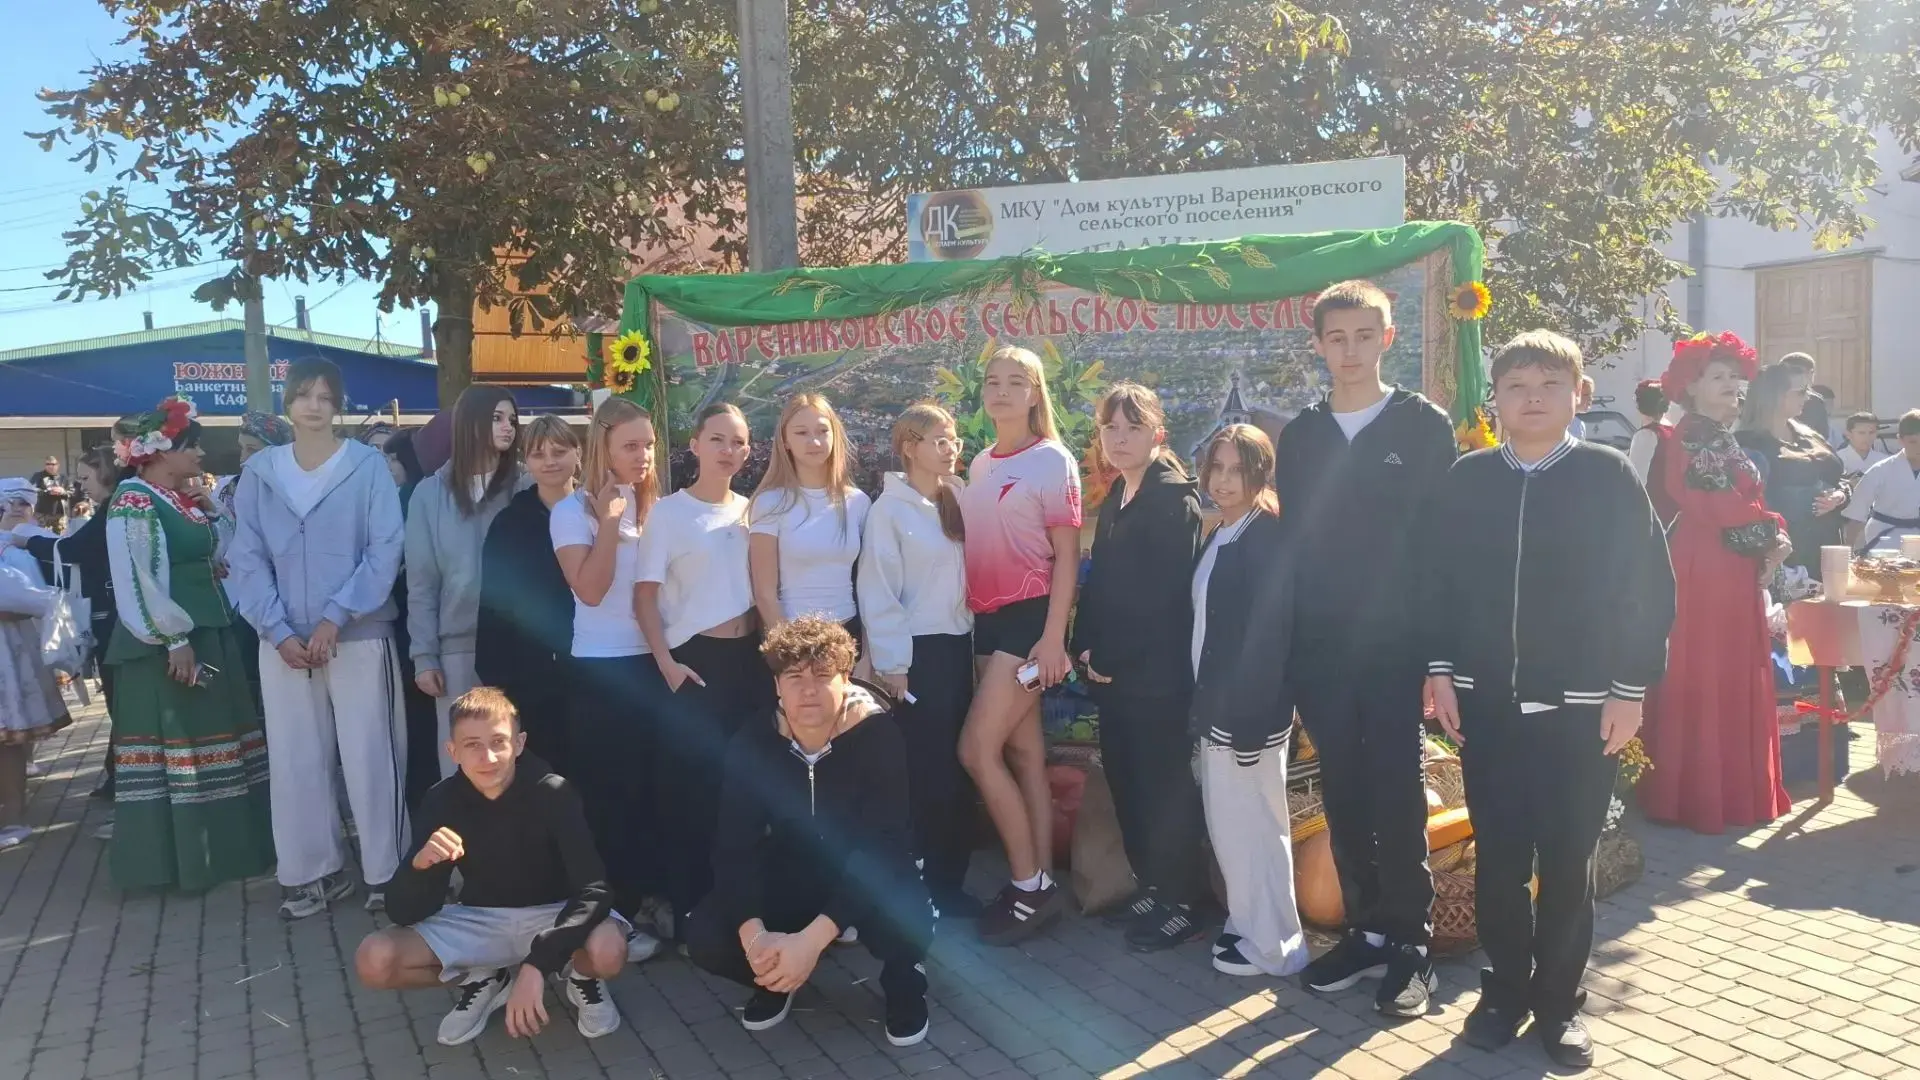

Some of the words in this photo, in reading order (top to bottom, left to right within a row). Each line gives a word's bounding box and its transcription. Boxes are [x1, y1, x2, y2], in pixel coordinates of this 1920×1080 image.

[1000, 199, 1046, 220] МКУ
[1053, 198, 1100, 217] "Дом
[1107, 192, 1205, 217] культуры
[1211, 179, 1382, 207] Варениковского
[1079, 211, 1183, 232] сельского
[1185, 198, 1302, 224] поселения"
[926, 204, 960, 241] ДК
[692, 305, 967, 366] ВАРЕНИКОВСКОЕ
[981, 296, 1159, 337] СЕЛЬСКОЕ
[173, 358, 293, 381] ЮЖНЙ
[214, 393, 248, 406] КАФ
